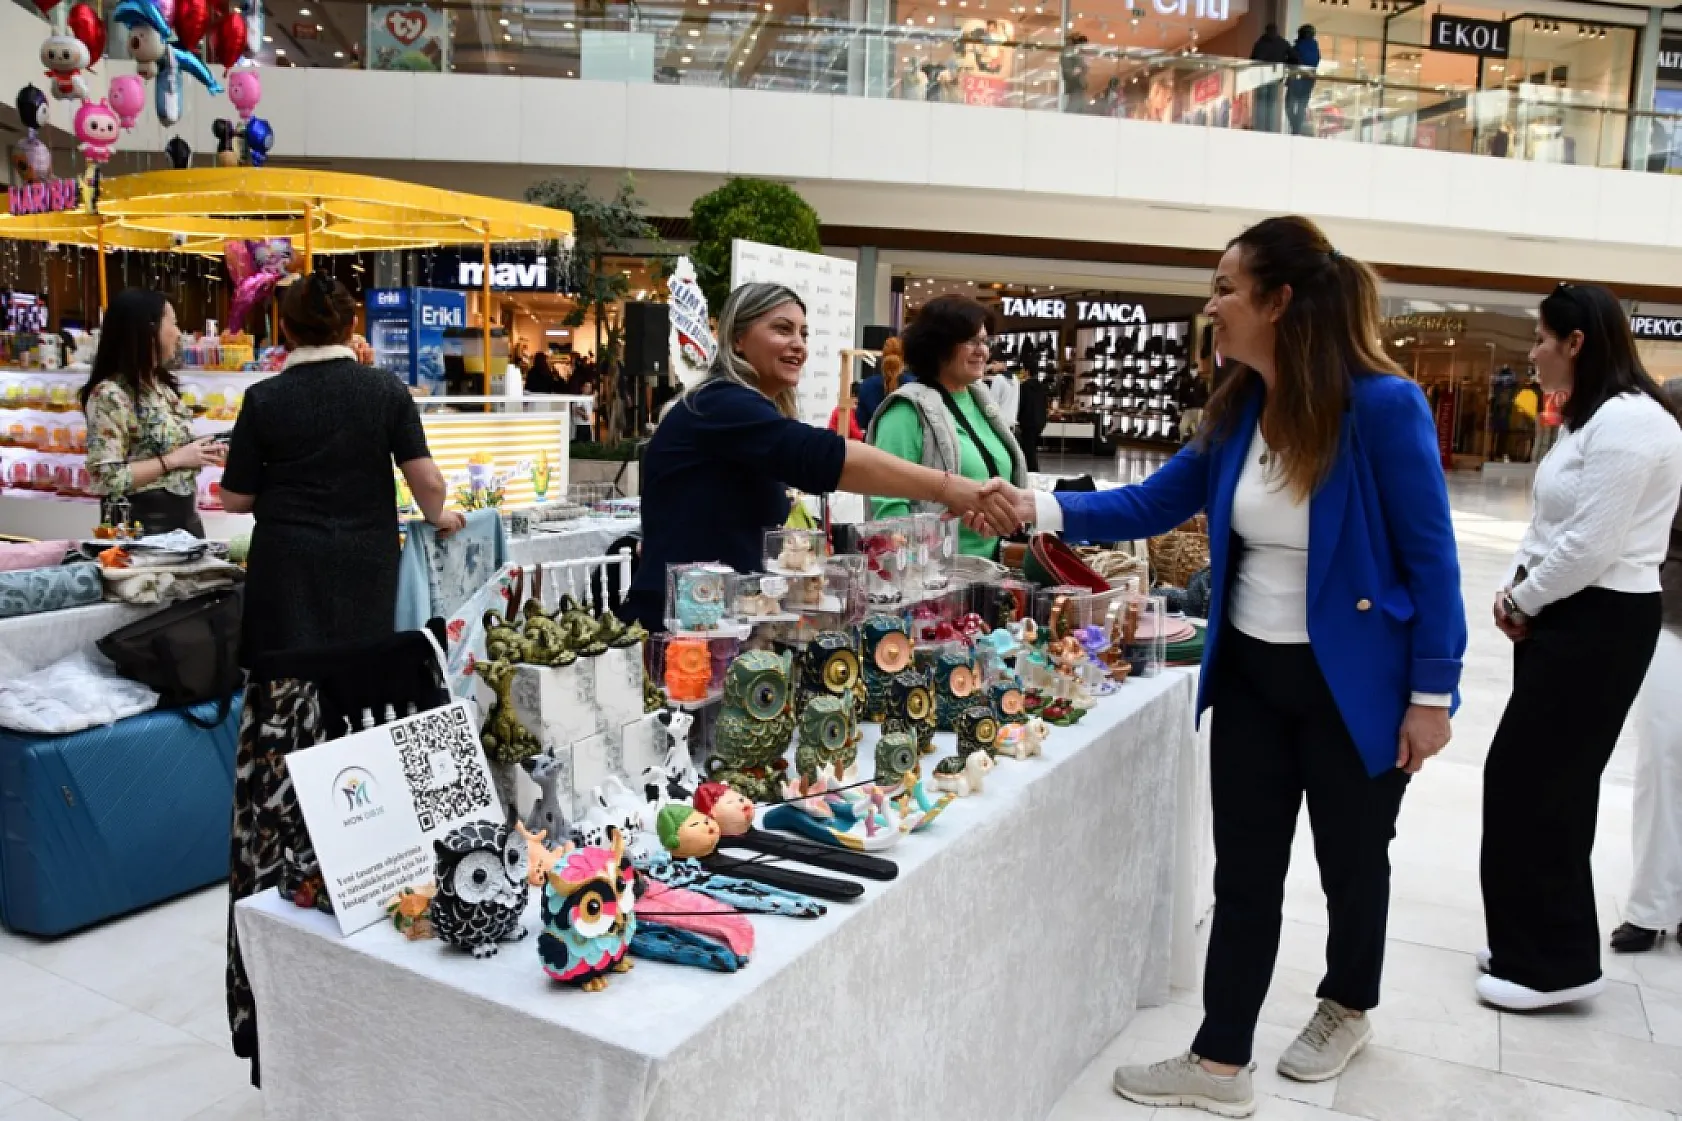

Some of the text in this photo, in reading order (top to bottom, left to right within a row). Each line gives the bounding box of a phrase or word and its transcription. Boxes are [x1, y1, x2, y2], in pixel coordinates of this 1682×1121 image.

[1439, 20, 1504, 51] EKOL
[8, 178, 76, 215] HARIBO
[459, 257, 547, 287] mavi
[422, 305, 463, 327] Erikli
[1001, 297, 1147, 323] TAMER TANCA
